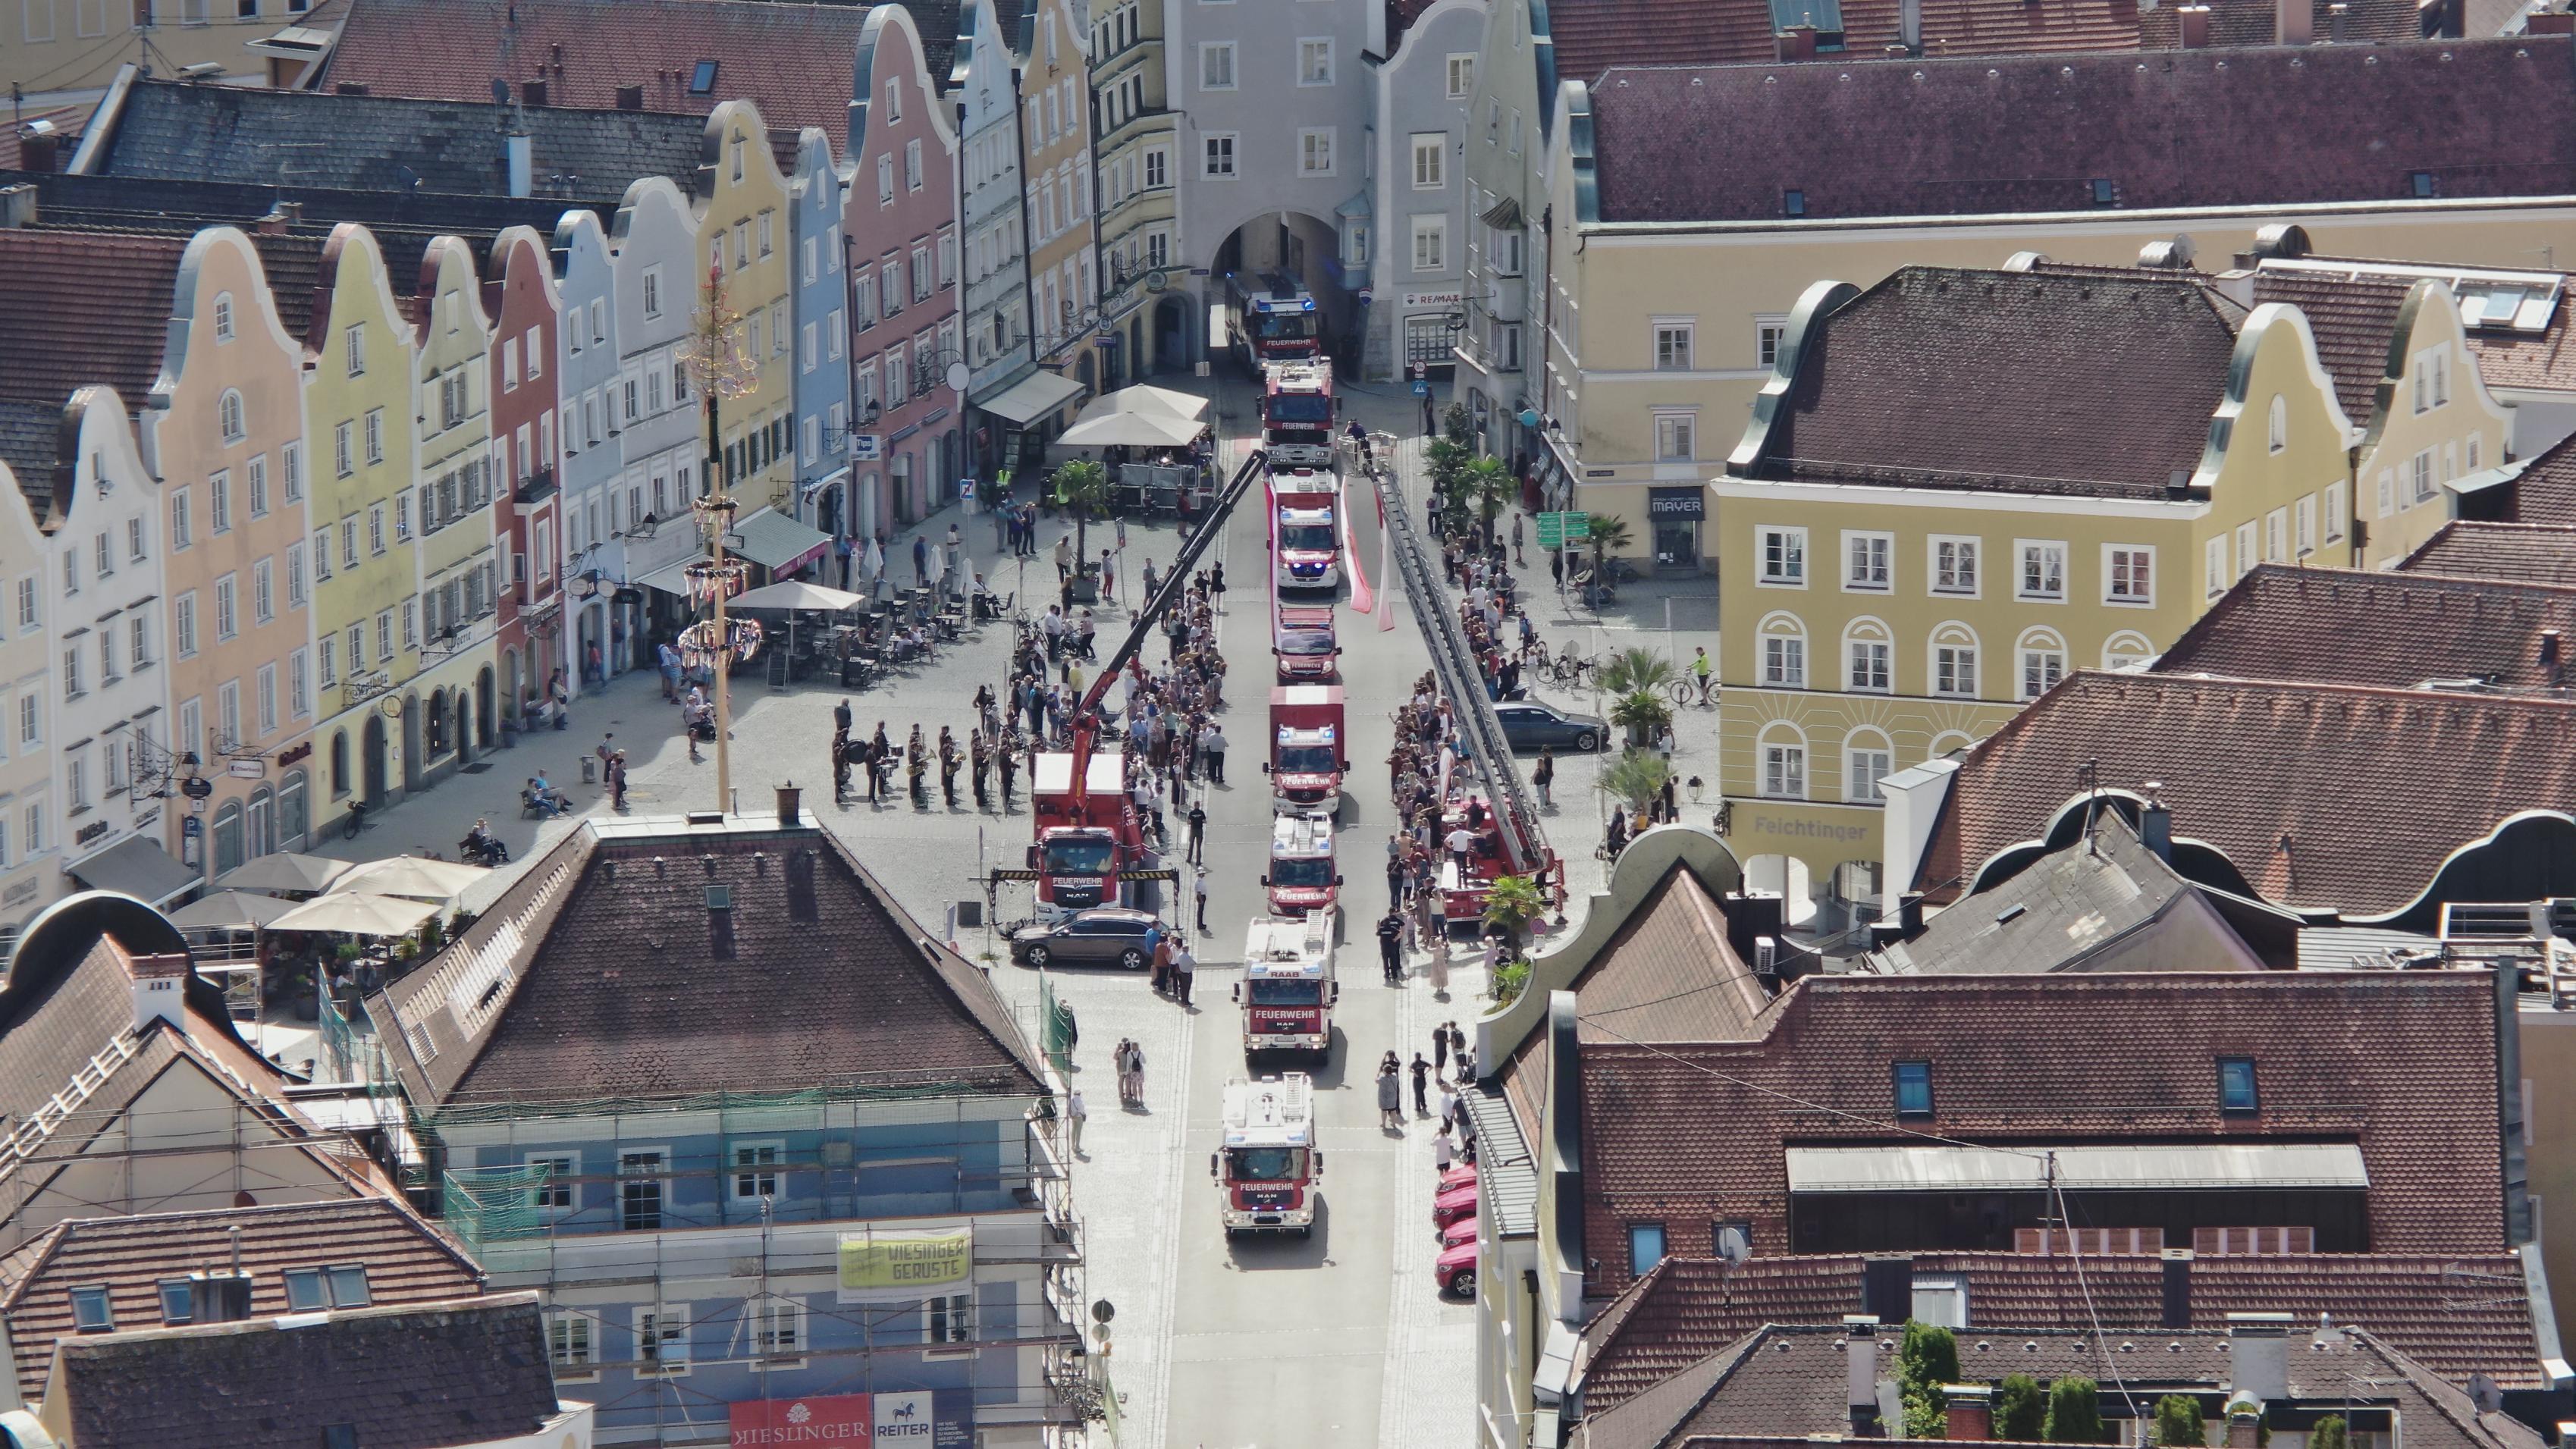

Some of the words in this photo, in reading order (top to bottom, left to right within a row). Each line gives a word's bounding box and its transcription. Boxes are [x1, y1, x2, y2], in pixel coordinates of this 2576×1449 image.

[1420, 294, 1460, 304] RE/MAX
[1266, 338, 1311, 347] FEUERWEHR
[1652, 501, 1701, 512] MAYER
[1282, 776, 1331, 785] FEUERWEHR
[187, 820, 196, 831] P
[1755, 816, 1868, 842] Feichtinger
[1053, 877, 1103, 885] FEUERWEHR
[1276, 892, 1327, 900] FEUERWEHR
[1255, 1010, 1315, 1019] FEUERWEHR
[1240, 1183, 1294, 1191] FEUERWEHR
[888, 1239, 965, 1261] WIESINGER
[733, 1422, 868, 1446] KIESLINGER
[877, 1423, 929, 1437] REITER
